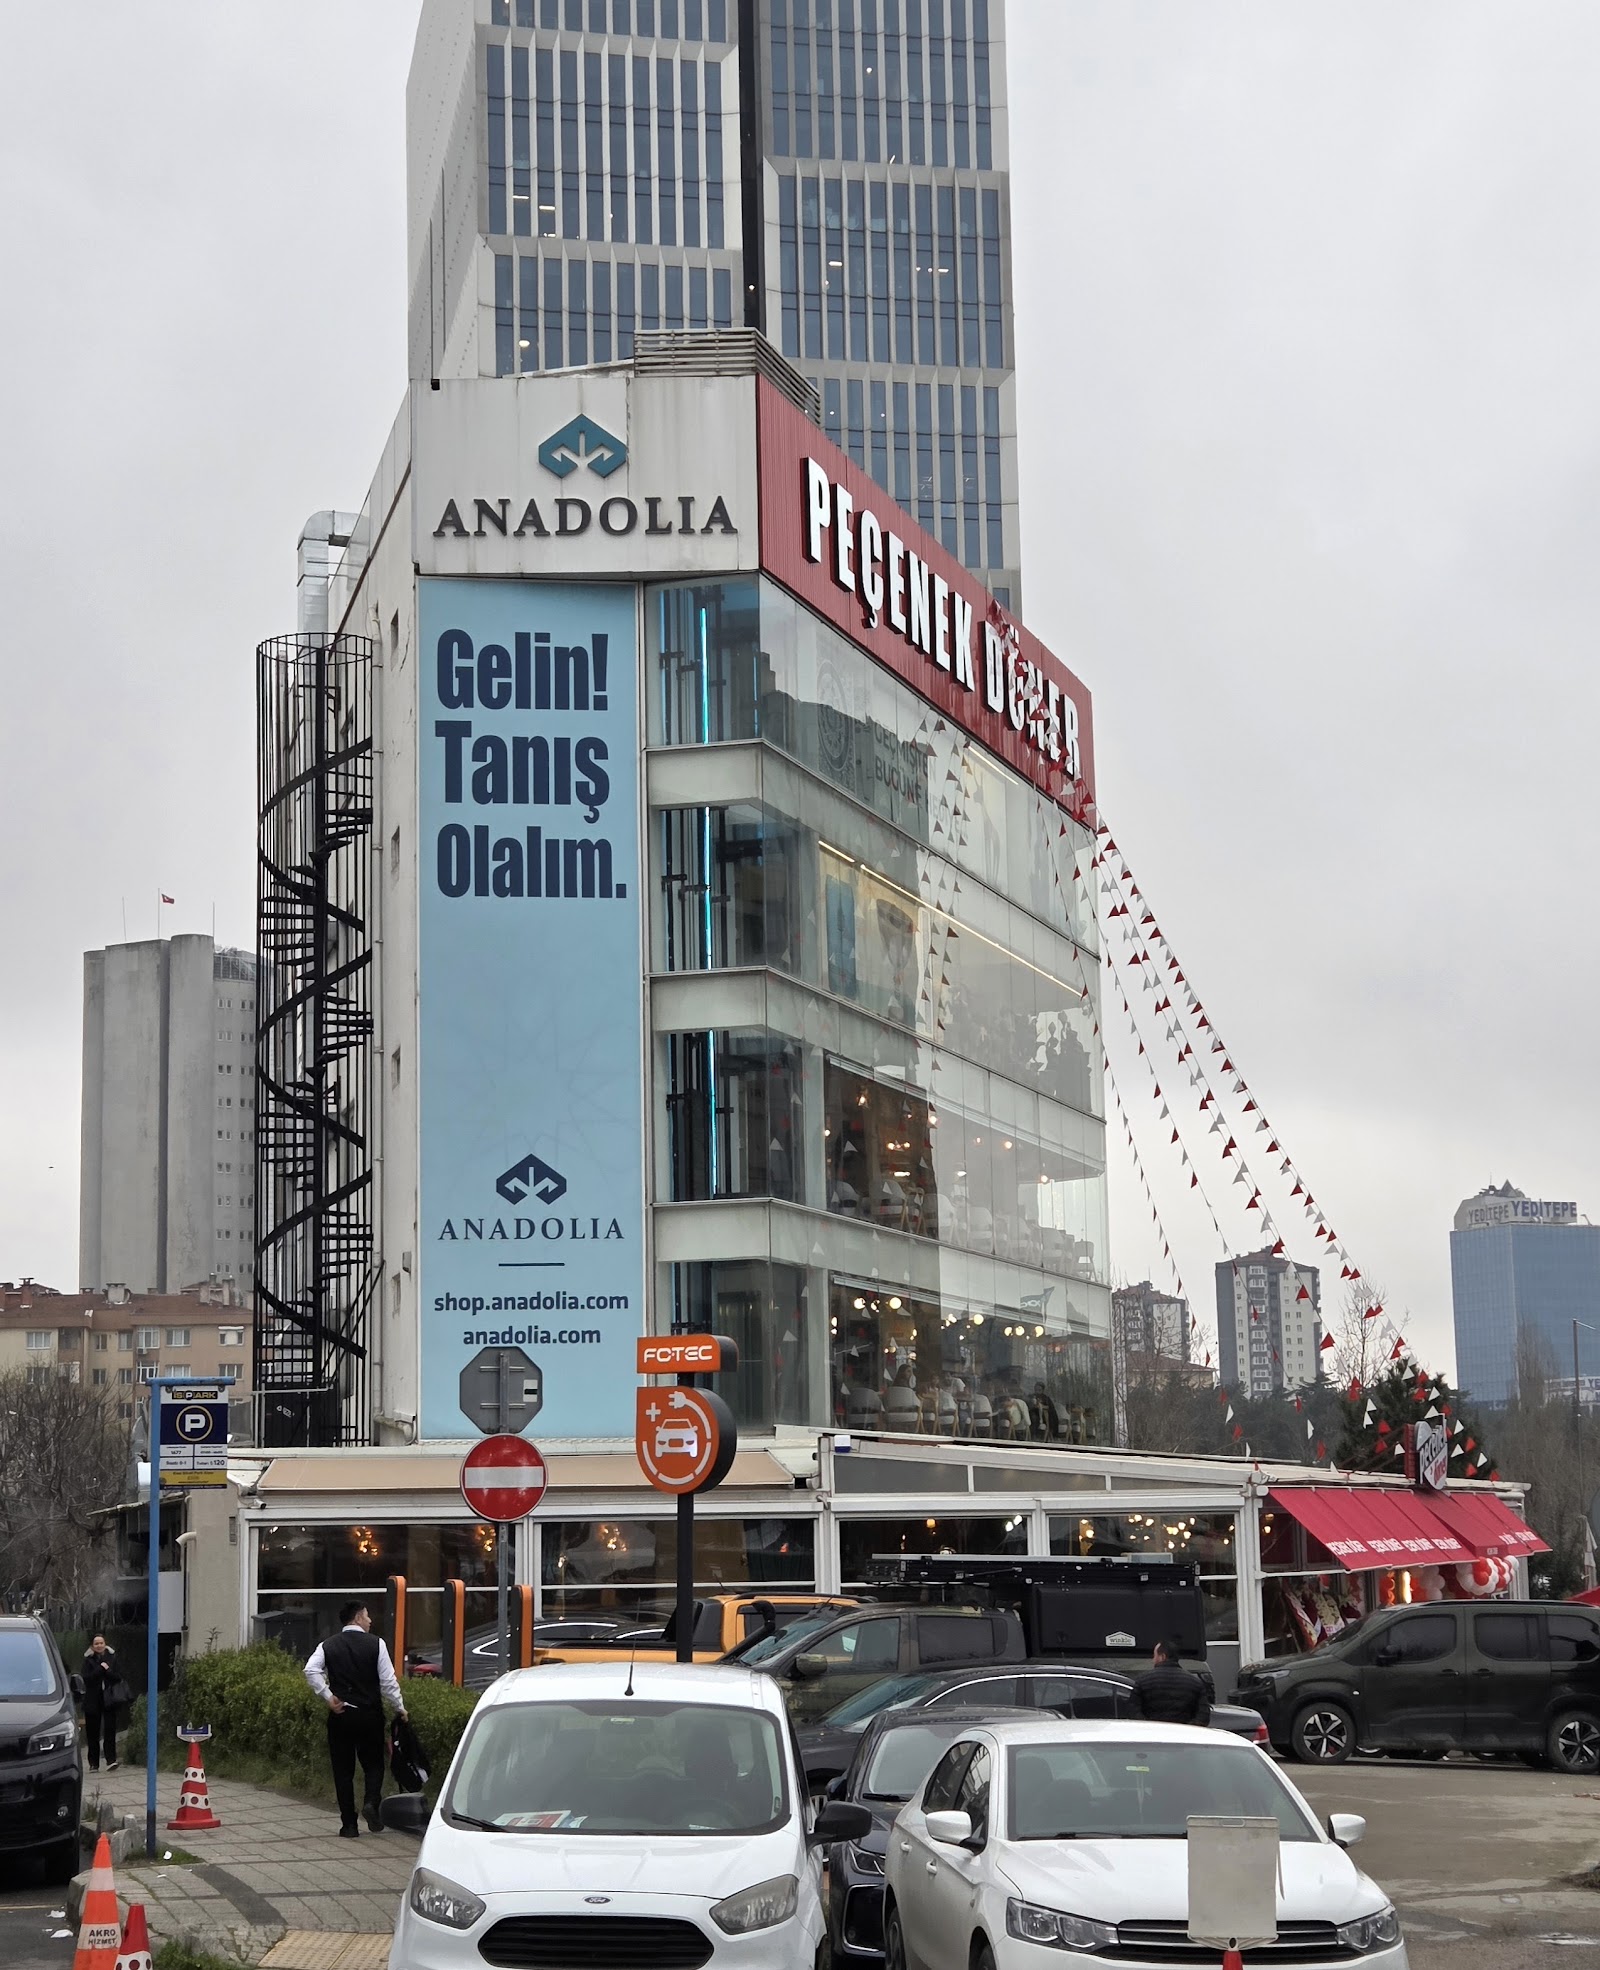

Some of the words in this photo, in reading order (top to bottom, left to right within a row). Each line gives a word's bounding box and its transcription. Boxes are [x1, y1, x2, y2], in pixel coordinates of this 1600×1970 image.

[433, 496, 738, 537] ANADOLIA
[803, 457, 974, 692] PEÇENEK
[436, 629, 609, 711] Gelin!
[435, 720, 610, 824] Tanış
[437, 823, 627, 899] Olalım.
[438, 1217, 625, 1240] ANADOLIA
[434, 1291, 629, 1316] shop.anadolia.com
[463, 1325, 601, 1345] anadolia.com
[643, 1345, 713, 1363] FOTEC
[185, 1414, 206, 1432] P
[89, 1929, 116, 1937] AKRO
